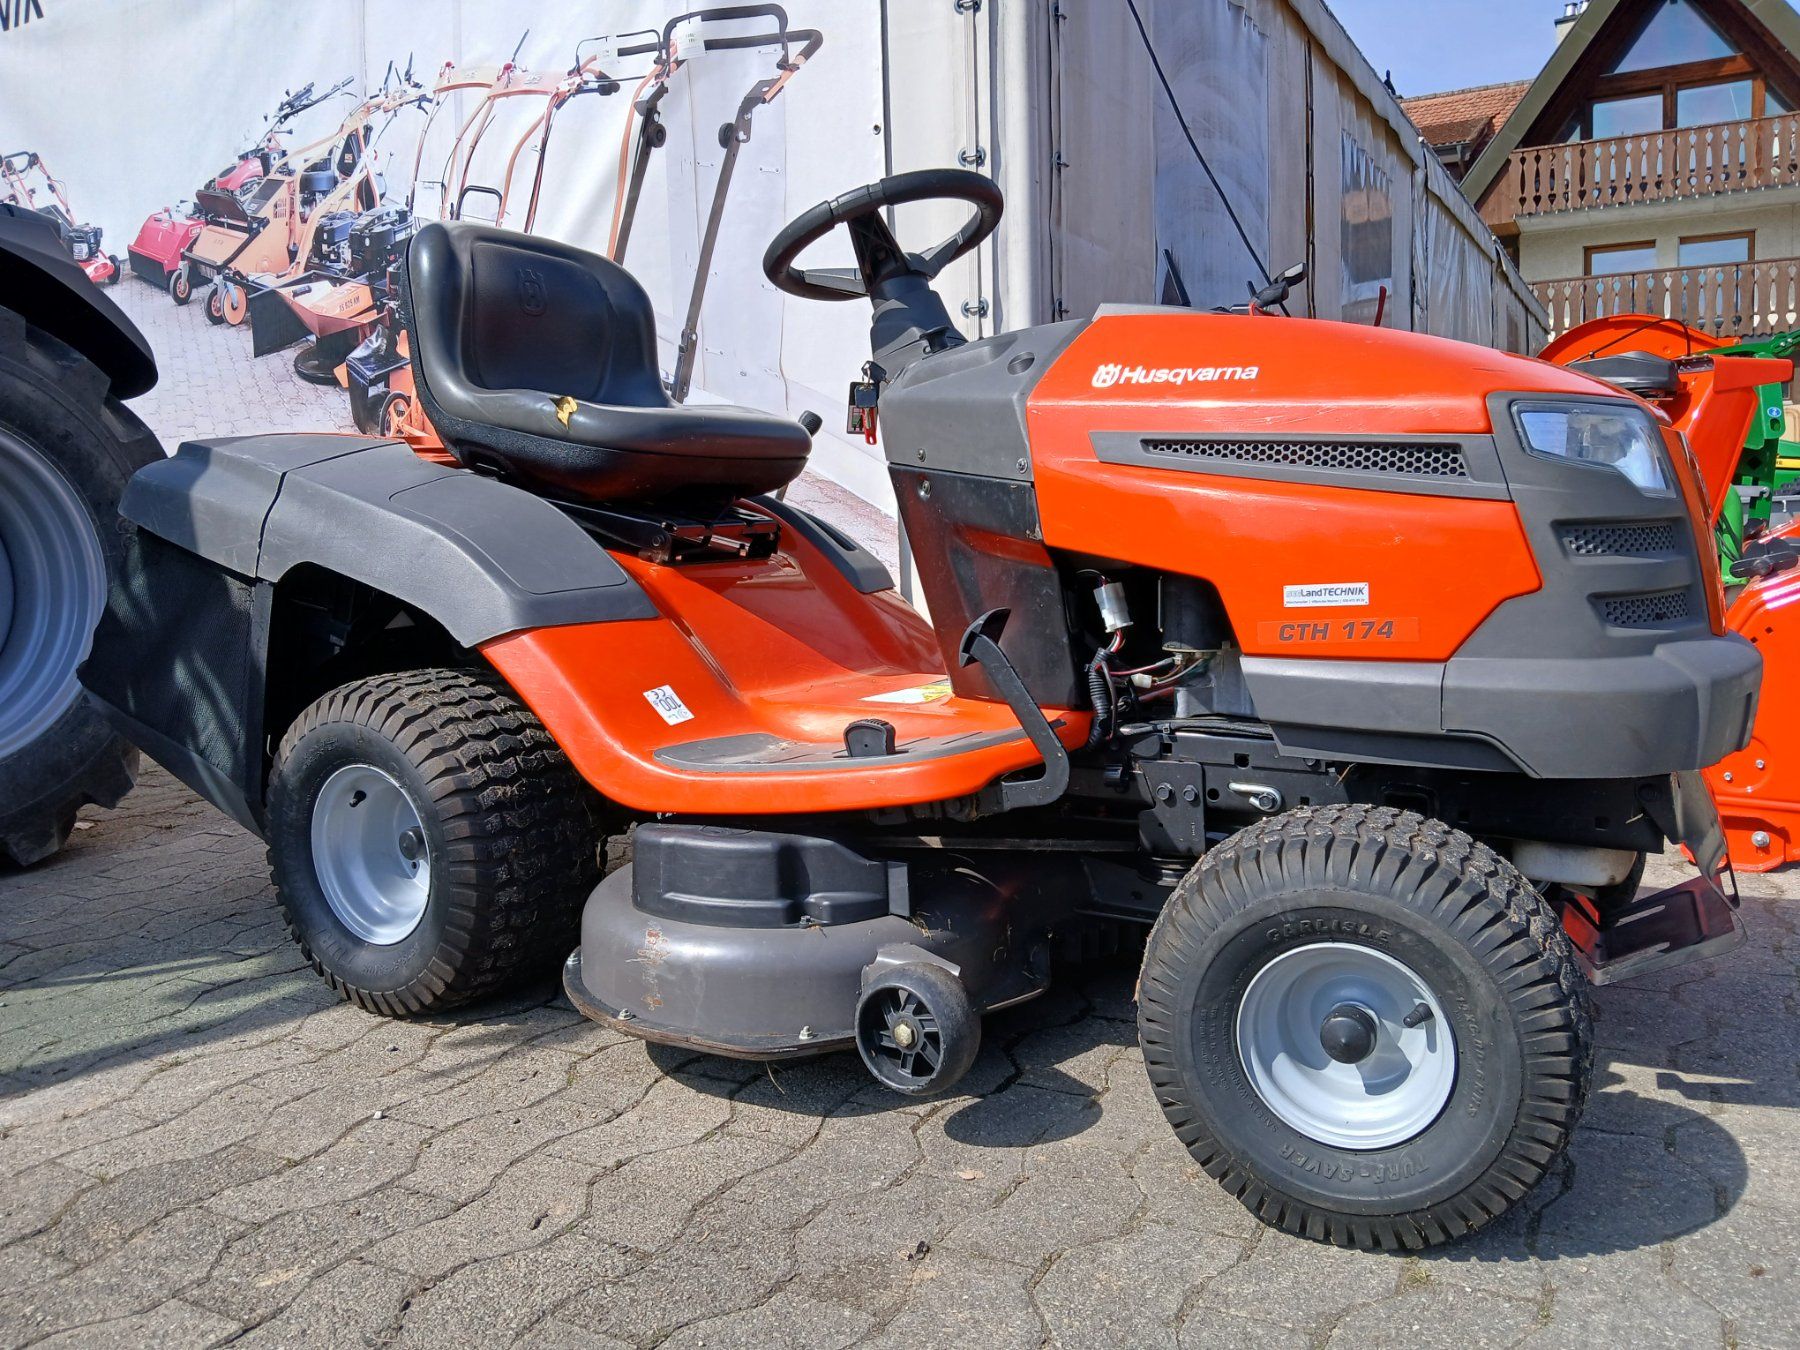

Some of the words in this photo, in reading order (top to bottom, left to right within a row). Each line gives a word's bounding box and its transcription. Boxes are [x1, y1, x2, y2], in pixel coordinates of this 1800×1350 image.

[1118, 365, 1259, 385] Husqvarna
[1279, 623, 1330, 641] CTH
[1343, 621, 1394, 639] 174
[659, 696, 681, 711] 100
[1265, 918, 1393, 943] CARLISLE
